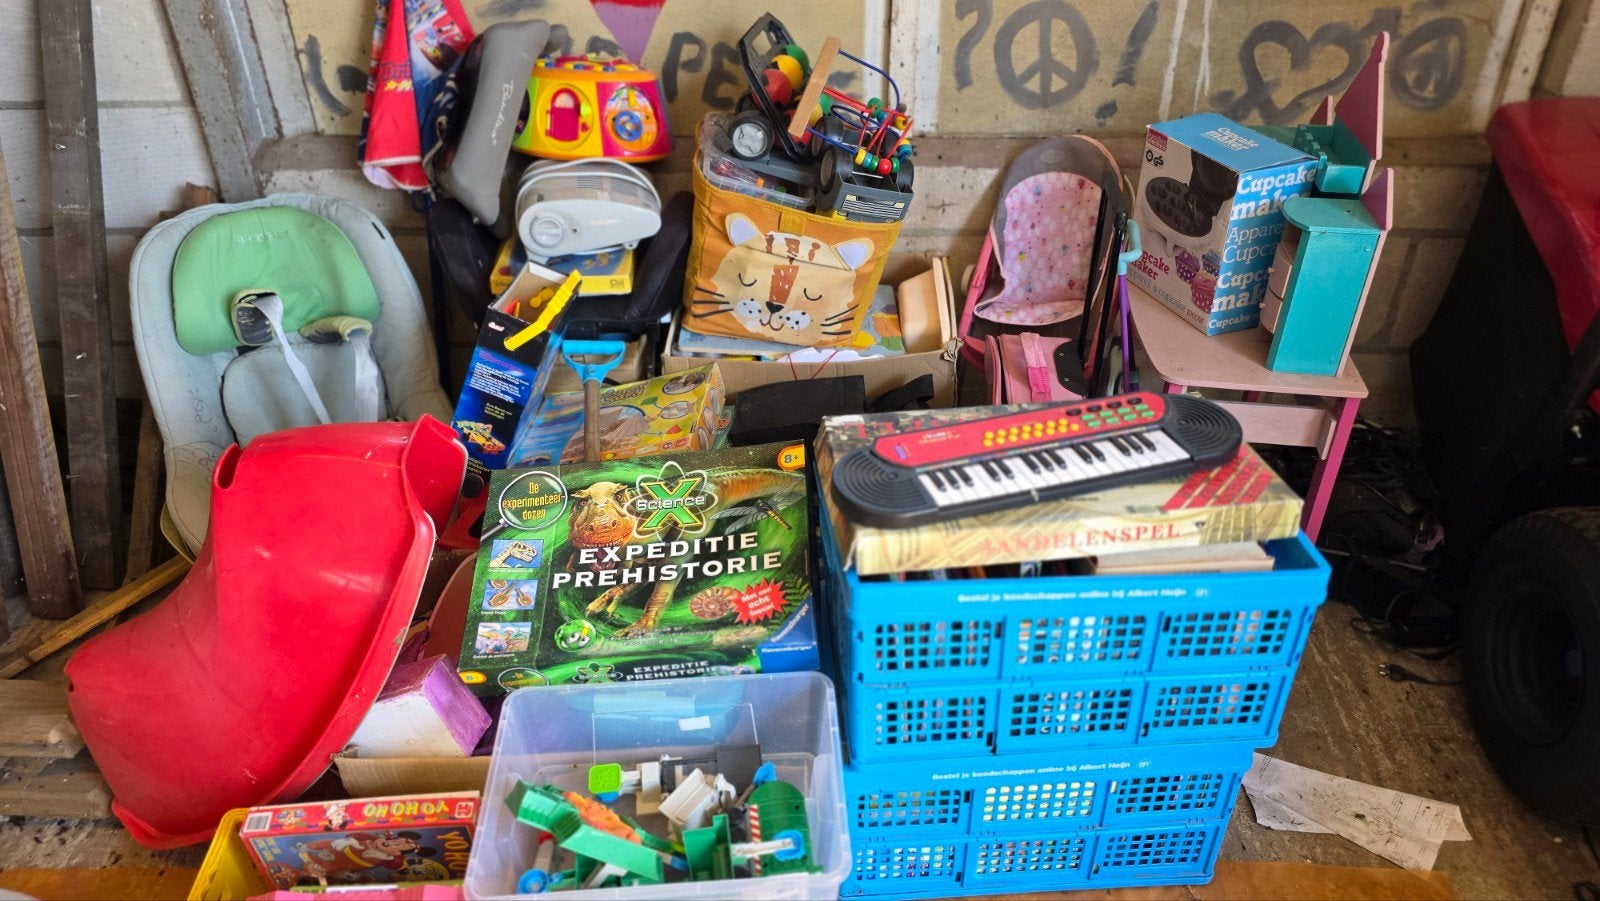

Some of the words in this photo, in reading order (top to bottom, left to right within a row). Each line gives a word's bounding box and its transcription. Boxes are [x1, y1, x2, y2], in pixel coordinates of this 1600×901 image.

[1237, 165, 1317, 195] Cupcake
[528, 482, 540, 495] De
[635, 493, 707, 511] Science
[522, 508, 546, 520] dozen
[577, 530, 759, 565] EXPEDITIE
[551, 550, 783, 589] PREHISTORIE
[747, 594, 772, 608] echt
[957, 594, 990, 602] Bestel
[1002, 591, 1077, 602] boodschappen
[1078, 590, 1109, 599] online
[1126, 587, 1159, 598] Albert
[771, 602, 811, 644] Ravensburger
[761, 643, 813, 655] Ravensburger
[633, 660, 710, 673] EXPEDITIE
[931, 773, 961, 781] Bestel
[961, 772, 971, 780] je
[971, 767, 1036, 779] boodschappen
[1037, 766, 1065, 774] online
[1066, 764, 1077, 773] bij
[1079, 762, 1106, 771] Albert
[1107, 761, 1131, 770] Heijn
